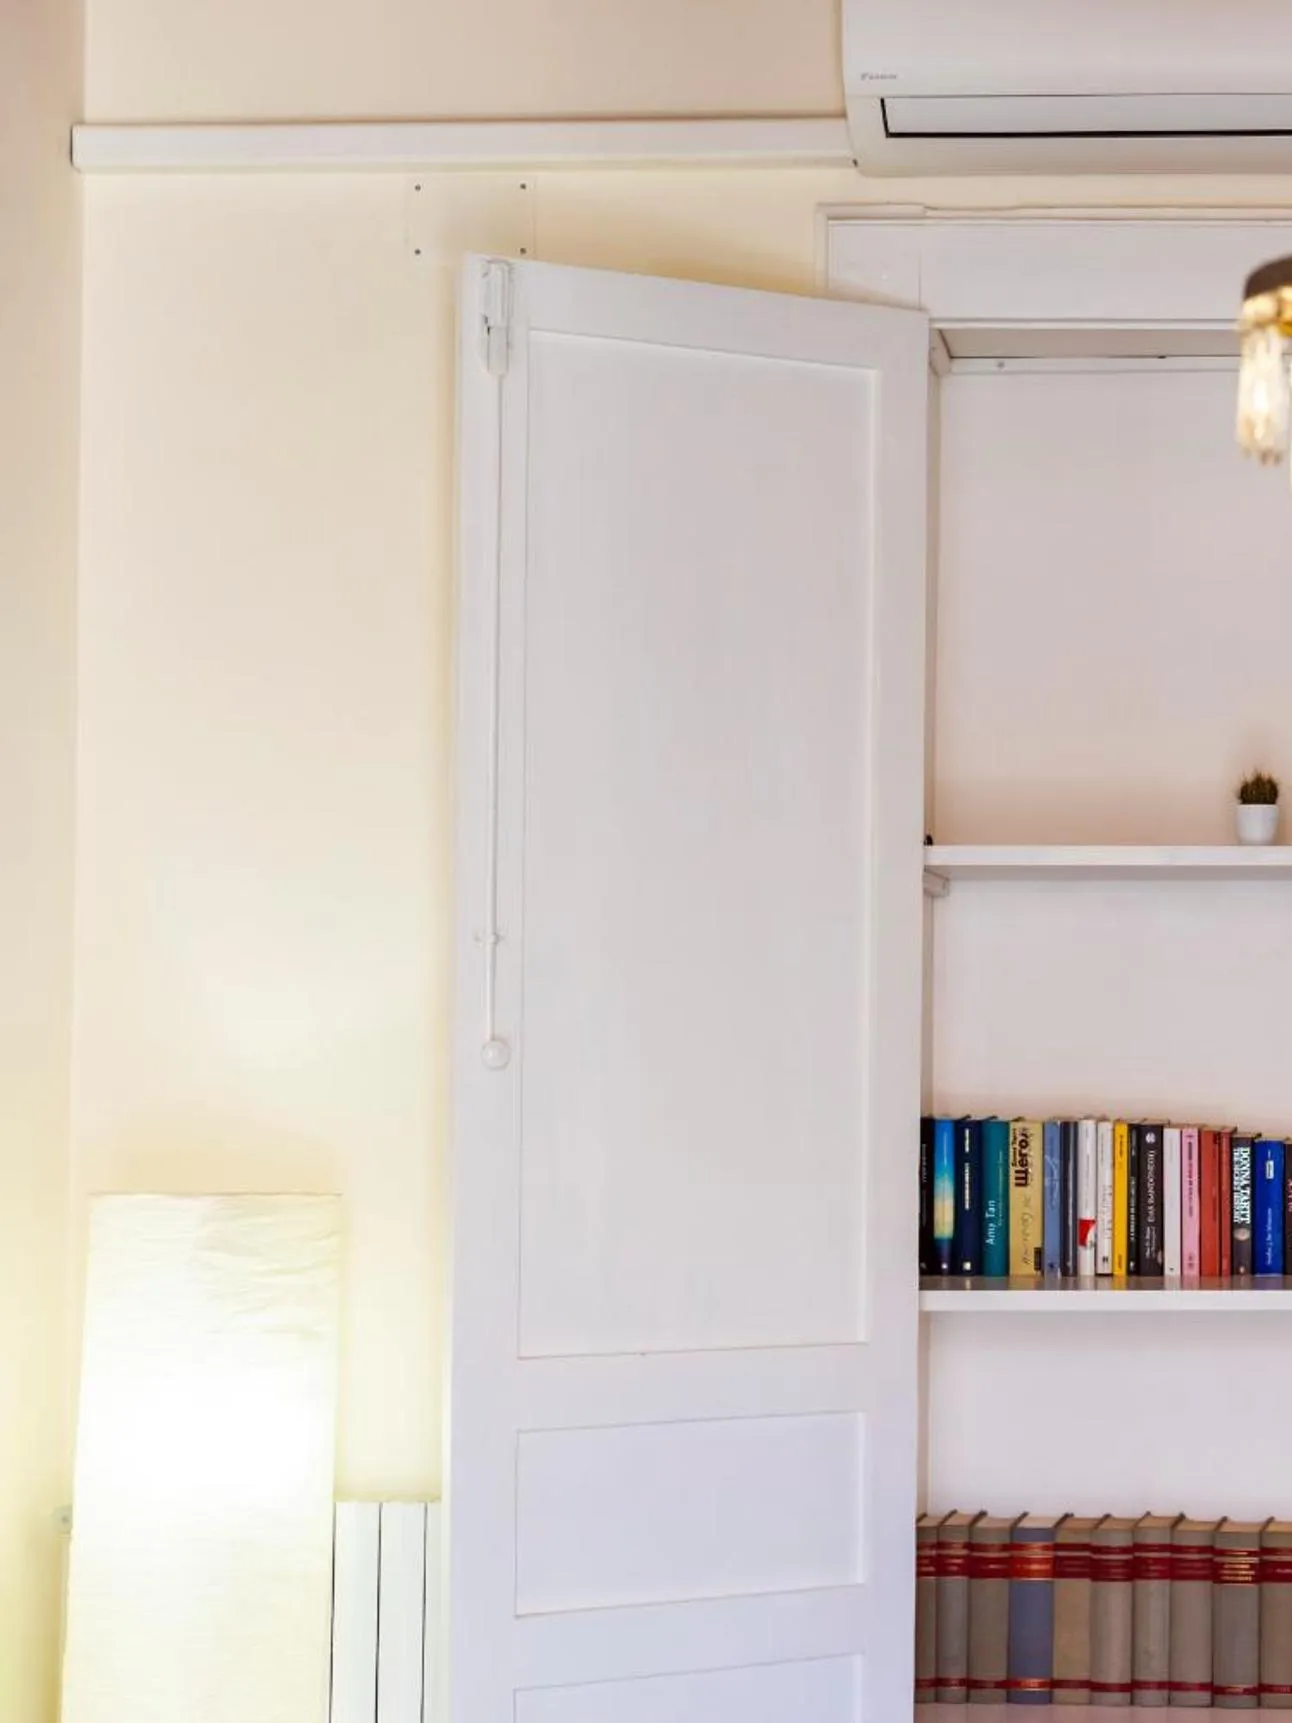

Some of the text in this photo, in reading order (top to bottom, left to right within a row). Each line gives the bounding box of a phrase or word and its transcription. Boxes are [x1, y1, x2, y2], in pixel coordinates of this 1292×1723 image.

[1240, 1146, 1251, 1225] DONNA TARTT
[985, 1200, 998, 1246] Amy Tan
